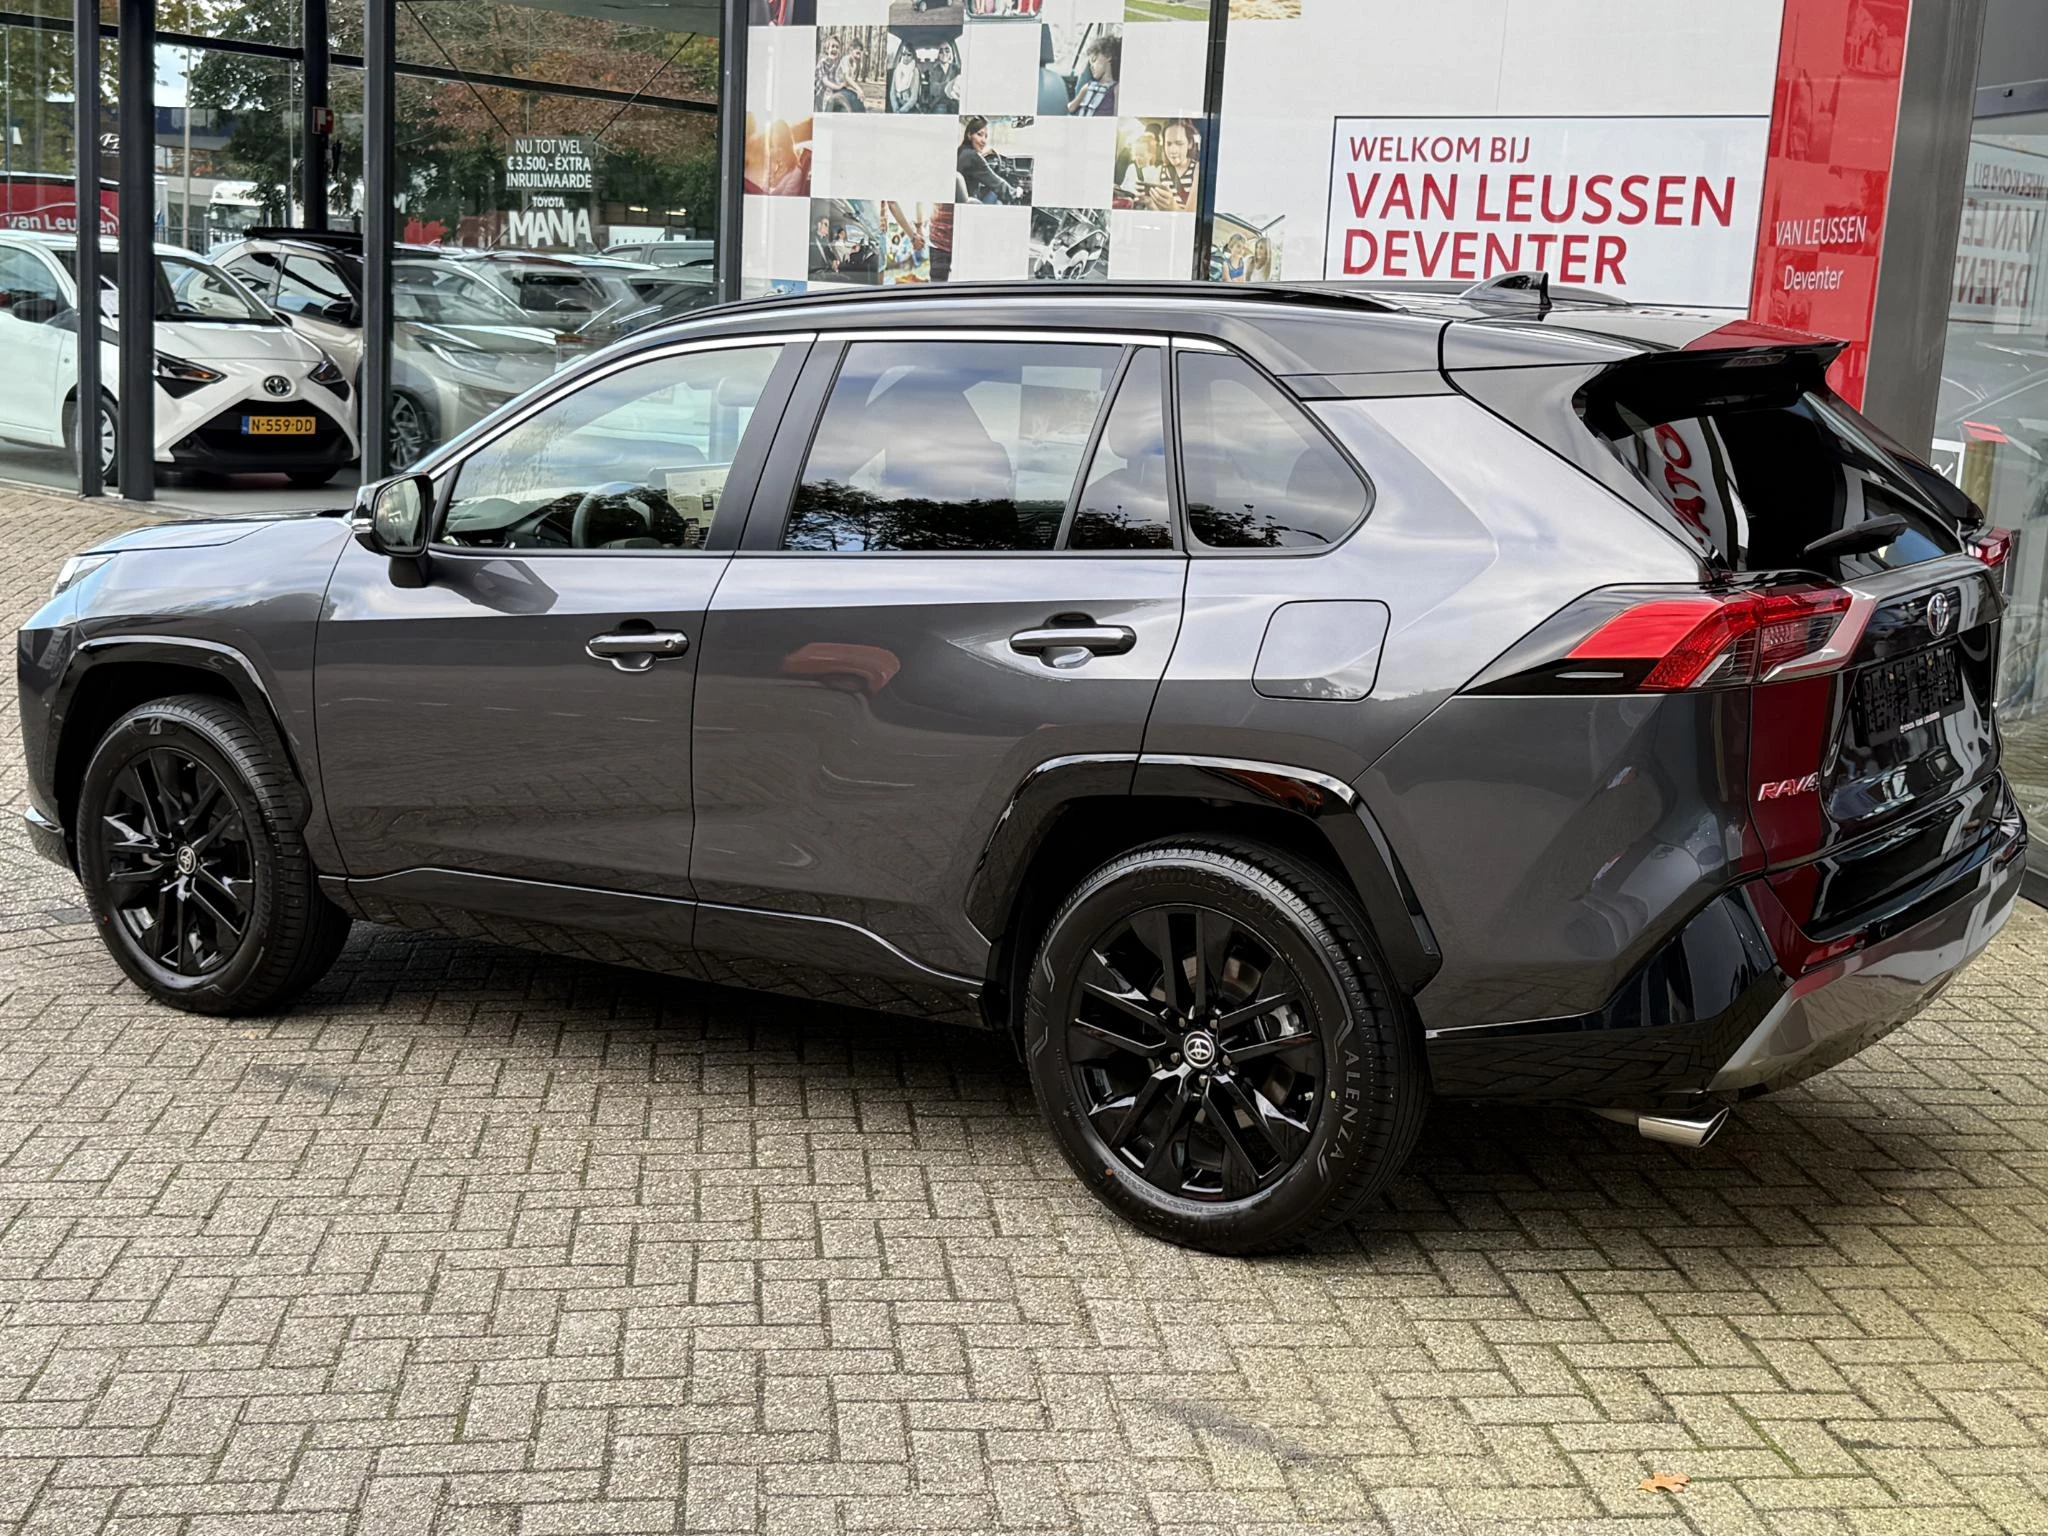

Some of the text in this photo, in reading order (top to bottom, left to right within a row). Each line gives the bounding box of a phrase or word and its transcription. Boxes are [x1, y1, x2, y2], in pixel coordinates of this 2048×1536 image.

[515, 139, 583, 154] NU TOT WEL
[1350, 136, 1530, 163] WELKOM BIJ
[506, 173, 593, 188] INRUILWAARDE
[532, 196, 565, 208] TOYOTA
[1346, 172, 1736, 227] VAN LEUSSEN
[6, 215, 41, 229] van
[508, 207, 593, 249] MANIA
[1776, 215, 1868, 246] VAN LEUSSEN
[1343, 229, 1627, 285] DEVENTER
[1783, 264, 1844, 290] Deventer
[251, 418, 313, 432] N-559-DD
[1757, 771, 1819, 801] RAV4
[1330, 1050, 1361, 1159] ALENZA
